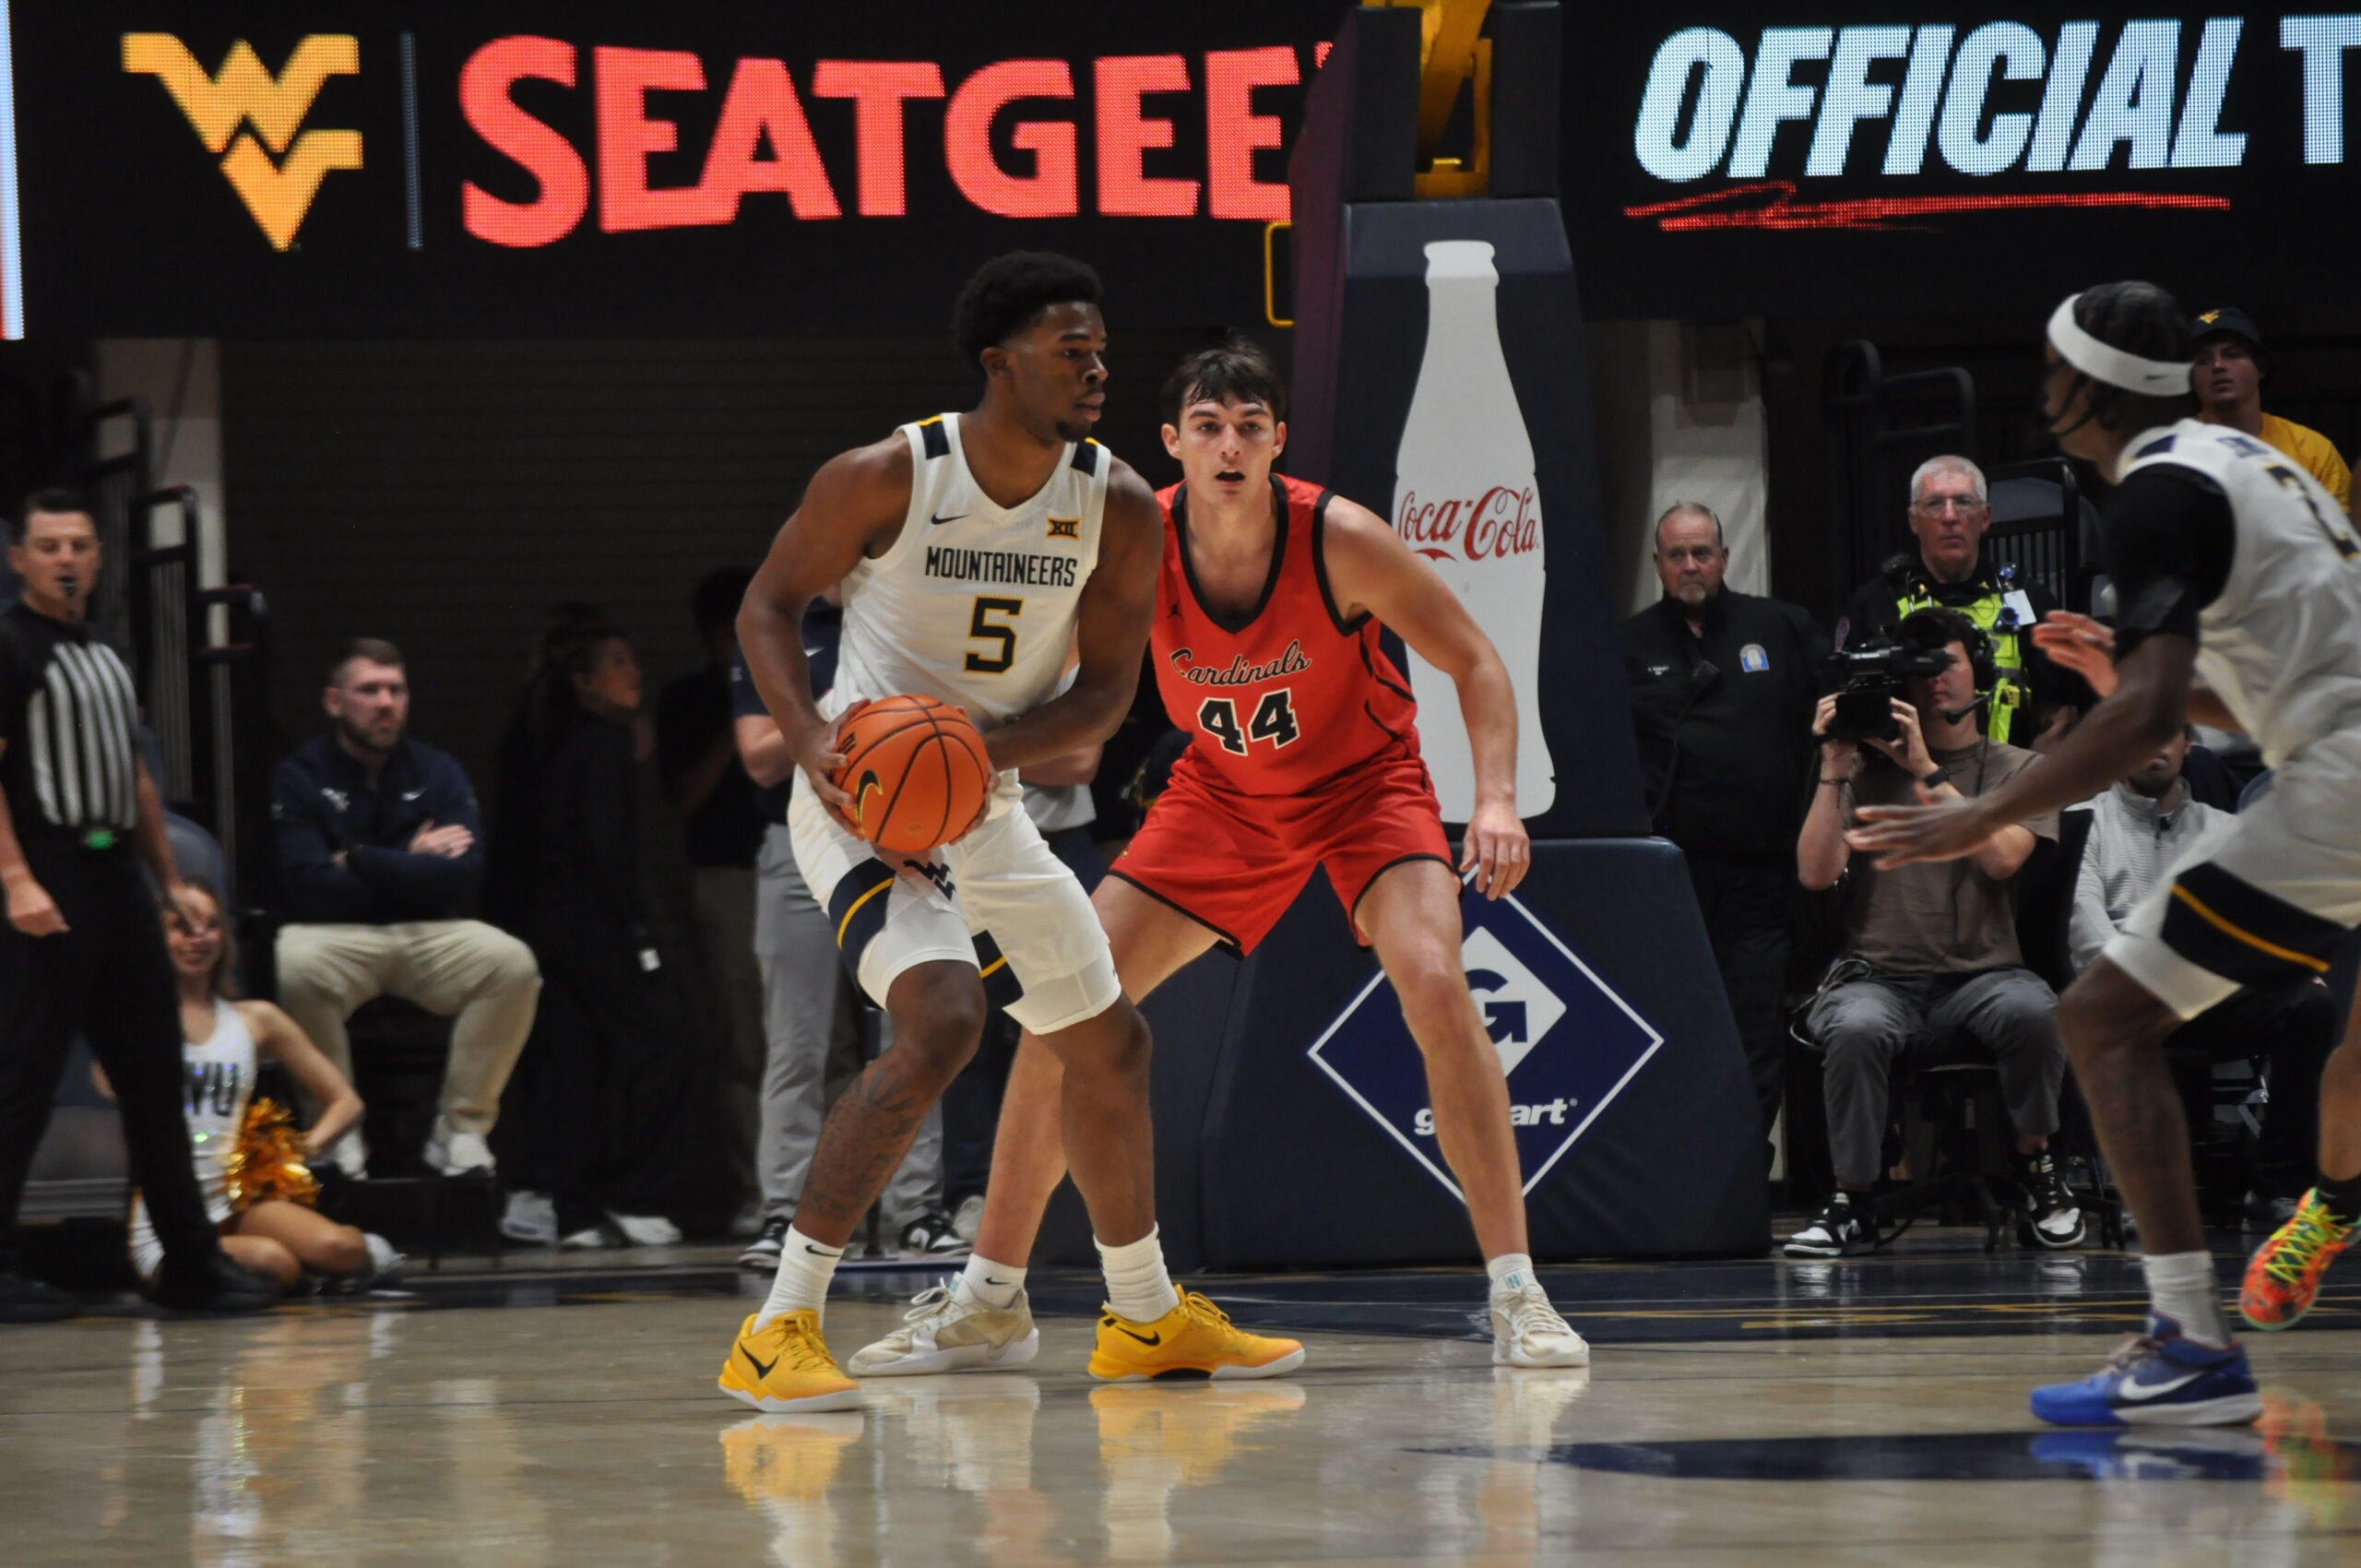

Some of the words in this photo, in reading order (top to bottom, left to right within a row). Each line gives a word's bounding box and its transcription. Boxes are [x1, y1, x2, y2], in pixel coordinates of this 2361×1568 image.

[1634, 20, 2247, 182] OFFICIAL
[458, 35, 1334, 247] SEATGEE
[1398, 486, 1536, 561] Coca-Cola
[925, 545, 1078, 587] MOUNTAINEERS
[964, 594, 1026, 676] 5
[1170, 638, 1313, 686] Cardinals
[1196, 686, 1300, 756] 44
[1414, 1098, 1569, 1136] gart
